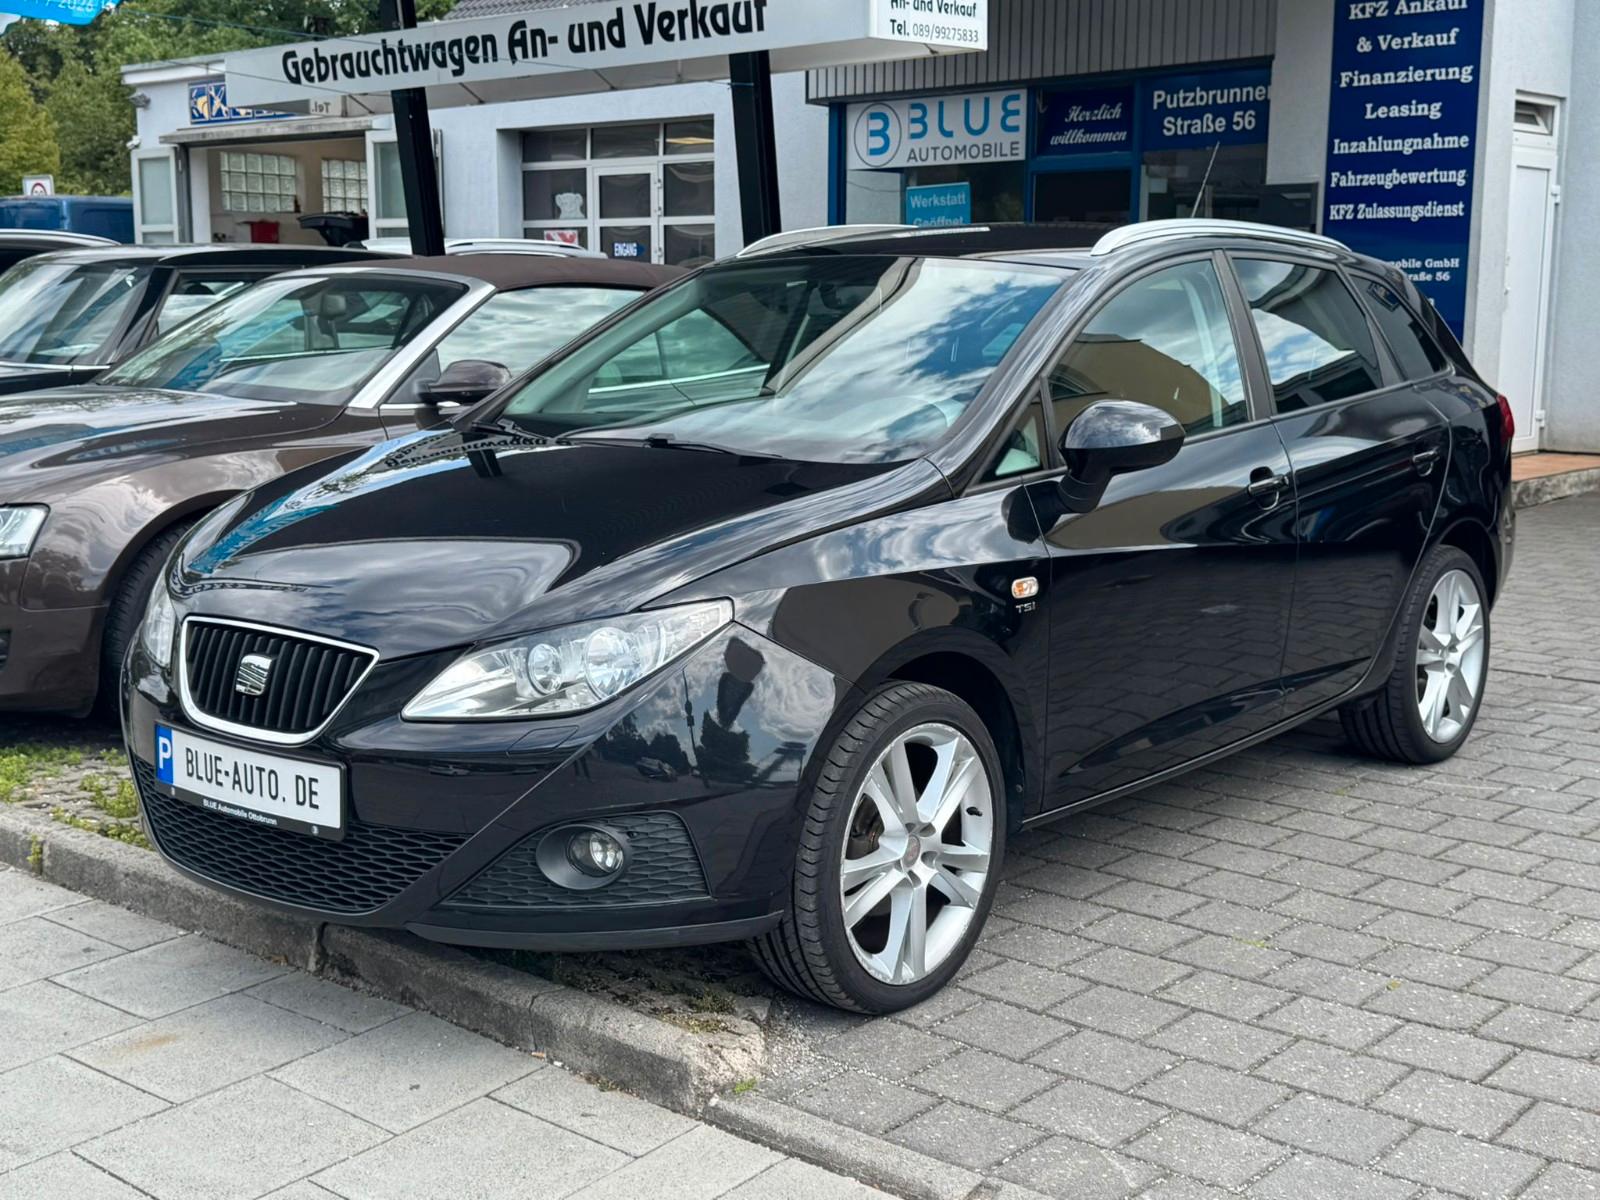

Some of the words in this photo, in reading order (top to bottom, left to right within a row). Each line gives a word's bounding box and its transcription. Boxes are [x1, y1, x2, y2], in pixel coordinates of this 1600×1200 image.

[913, 0, 933, 13] und
[937, 0, 976, 17] Verkauf
[1348, 0, 1389, 20] KFZ
[890, 19, 909, 36] Tel.
[912, 23, 979, 43] 089/99275833
[1356, 36, 1373, 53] &
[1377, 27, 1460, 51] Verkauf
[282, 34, 498, 85] Gebrauchtwagen
[508, 20, 558, 65] An-
[568, 8, 626, 54] und
[634, 0, 767, 46] Verkauf
[1339, 65, 1474, 88] Finanzierung
[908, 93, 1021, 140] BLUE
[1064, 102, 1122, 123] Herzlich
[1364, 99, 1443, 120] Leasing
[1162, 112, 1226, 137] Straße
[1232, 110, 1256, 131] 56
[1050, 128, 1127, 145] willkommen
[1333, 132, 1470, 155] Inzahlungnahme
[907, 141, 1020, 163] AUTOMOBILE
[1330, 168, 1467, 190] Fahrzeugbewertung
[910, 191, 967, 208] Werkstatt
[1329, 204, 1355, 220] KFZ
[1357, 200, 1465, 222] Zulassungsdienst
[1424, 258, 1460, 268] GmbH
[1435, 271, 1451, 281] 56
[1015, 601, 1036, 614] TSI
[158, 736, 172, 769] P
[295, 774, 320, 810] DE
[203, 799, 217, 810] BLUE
[218, 803, 248, 818] Automobile
